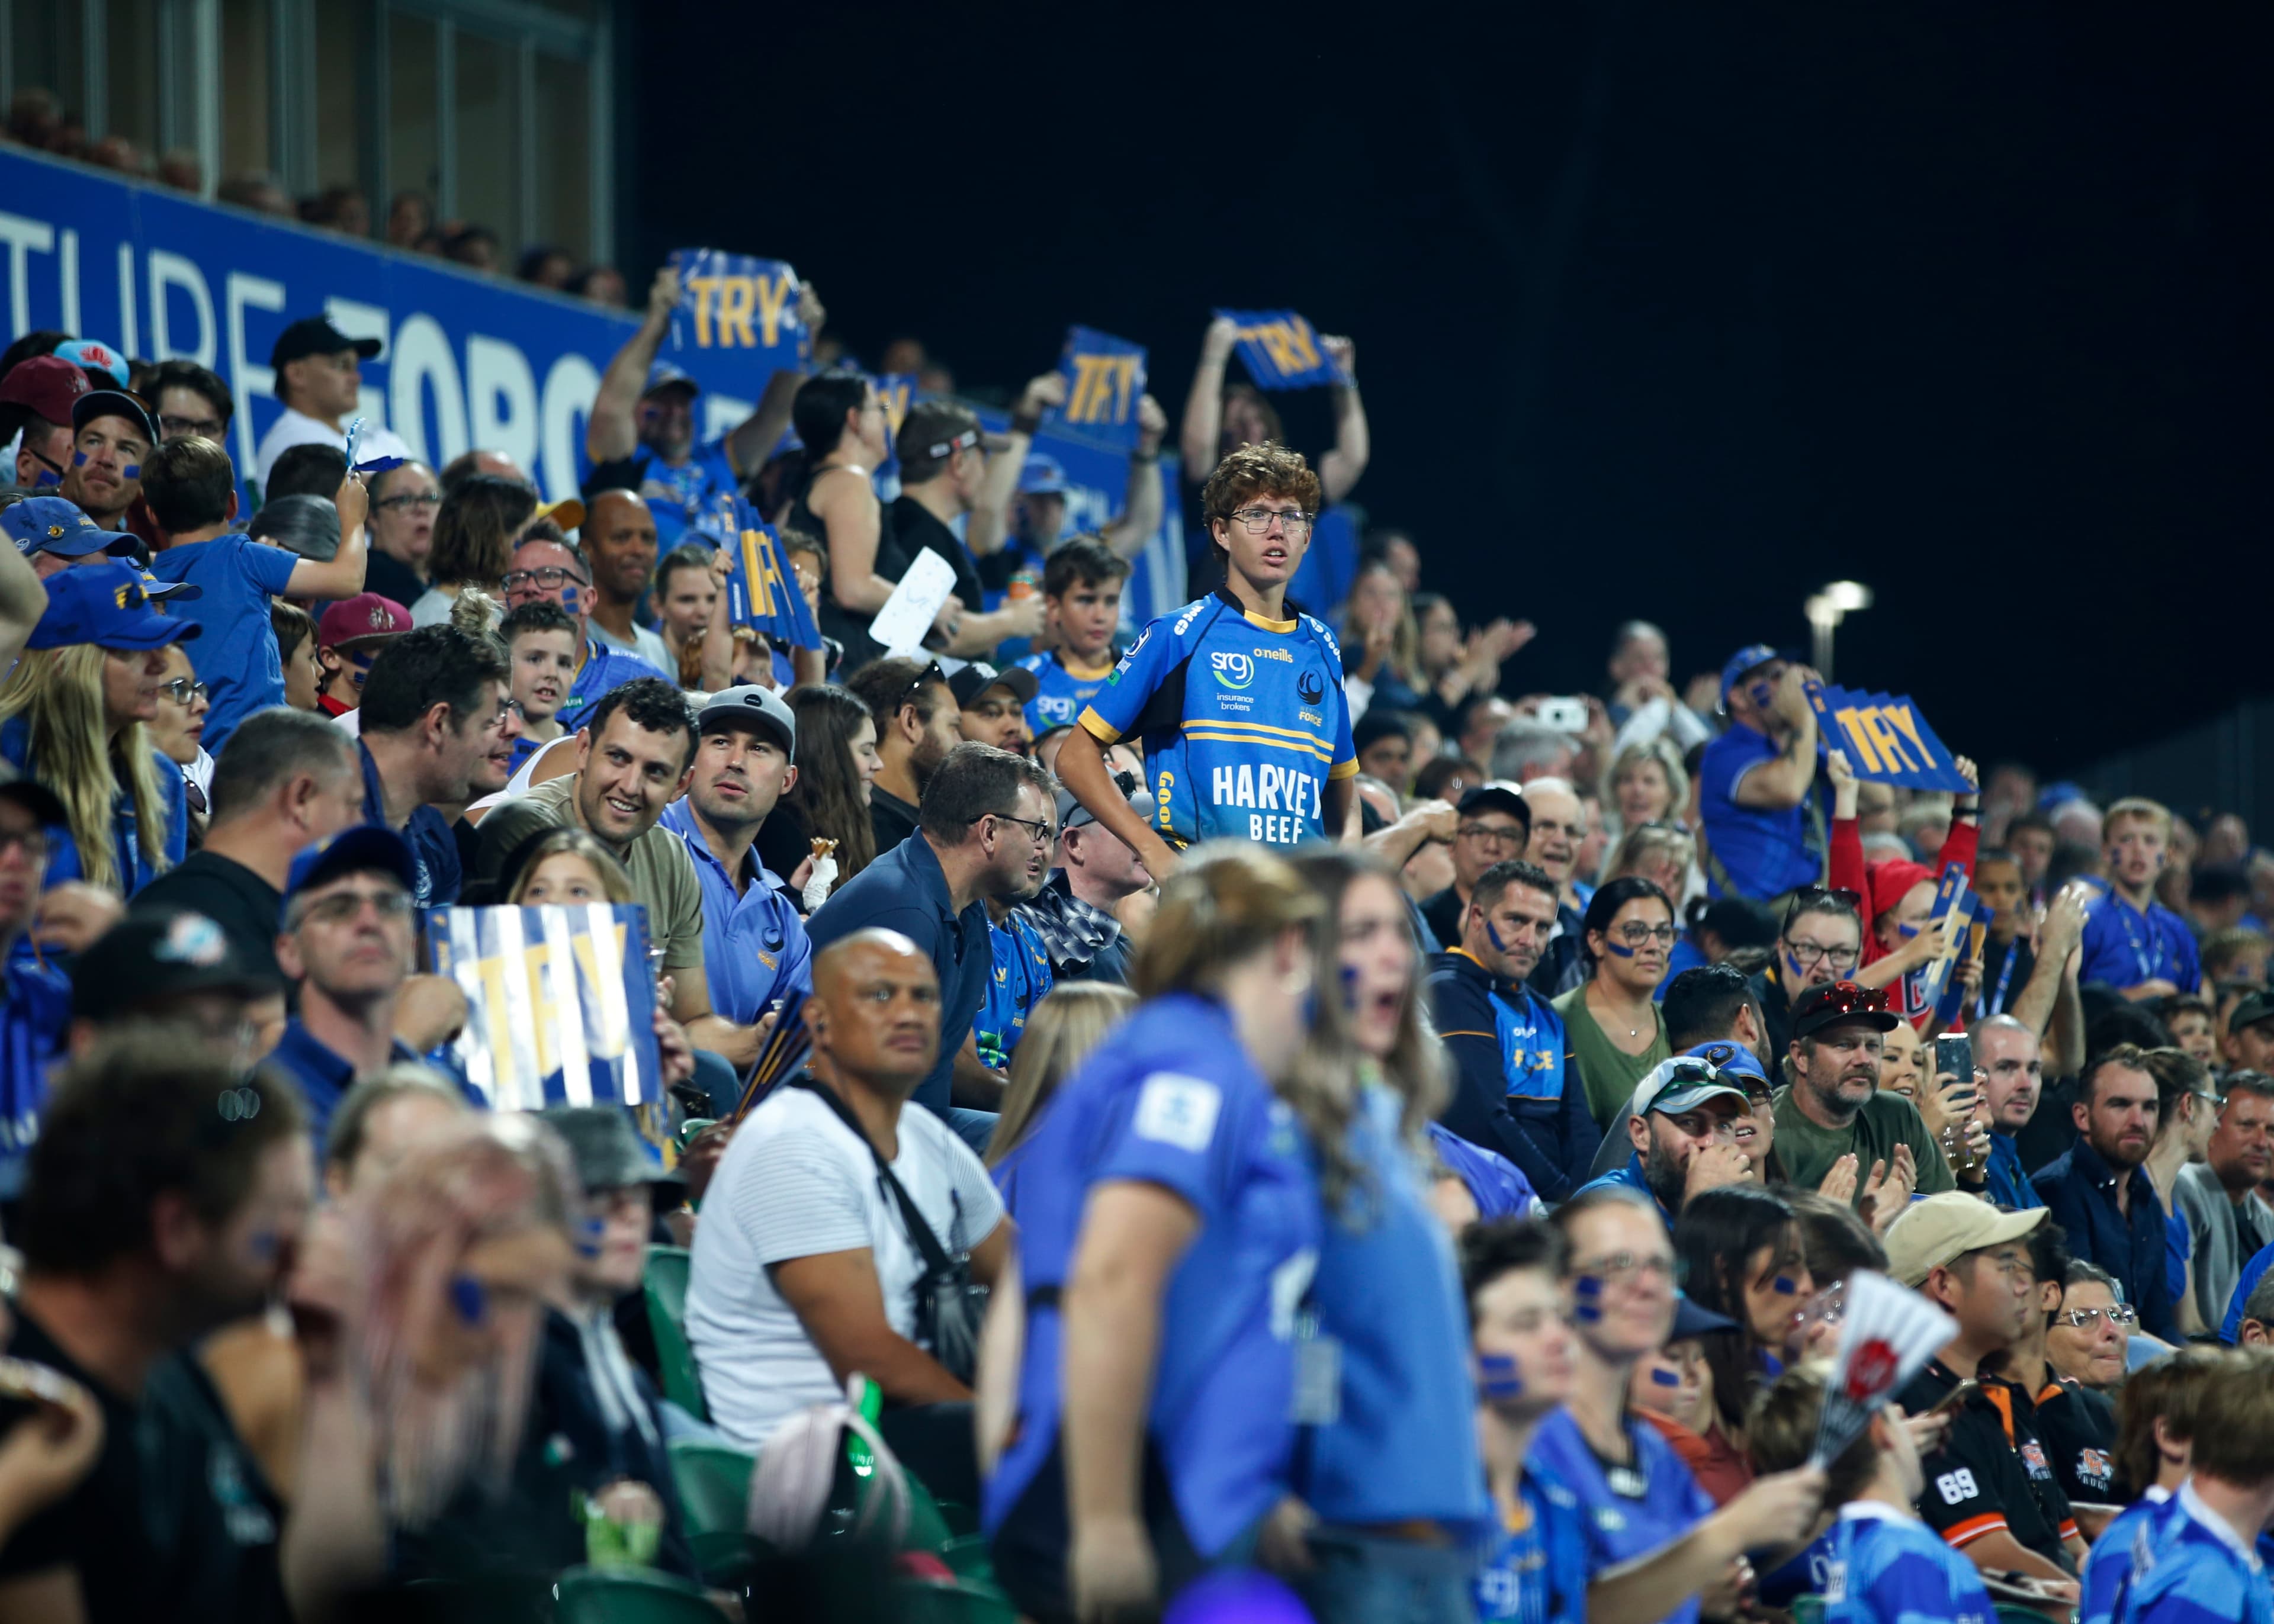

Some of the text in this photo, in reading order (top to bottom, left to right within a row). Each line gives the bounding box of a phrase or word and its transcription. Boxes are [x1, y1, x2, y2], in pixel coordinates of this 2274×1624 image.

[688, 275, 791, 349] TRY
[1211, 651, 1248, 680] srg
[1253, 648, 1293, 663] o'neills
[1216, 693, 1254, 703] insurance
[1220, 702, 1251, 712] brokers
[1299, 711, 1322, 727] FORCE
[1835, 705, 1938, 774] TRY
[1250, 813, 1303, 844] BEEF
